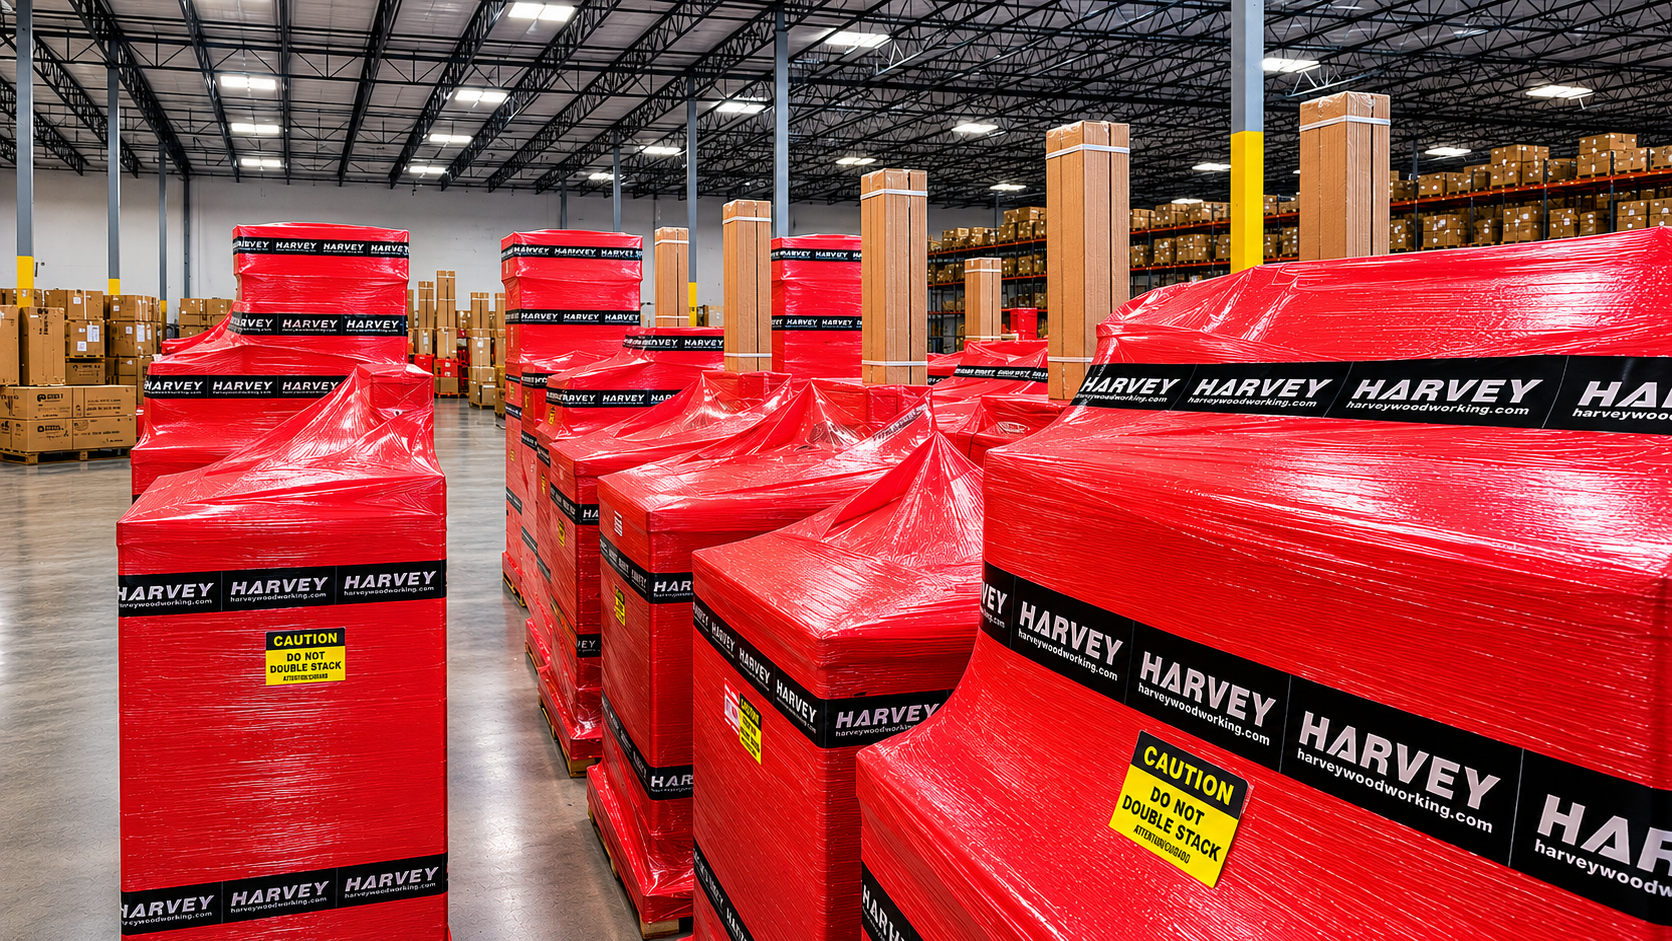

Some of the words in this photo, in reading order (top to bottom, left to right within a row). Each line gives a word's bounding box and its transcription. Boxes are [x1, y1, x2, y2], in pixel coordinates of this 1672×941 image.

[276, 241, 317, 250] HARVEY
[323, 242, 365, 251] HARVEY
[282, 319, 339, 329] HARVEY
[346, 320, 399, 329] HARVEY
[521, 312, 558, 320] HARVEY
[213, 381, 273, 391] HARVEY
[282, 381, 339, 391] HARVEY
[1079, 376, 1180, 394] HARVEY
[1193, 378, 1333, 398] HARVEY
[1352, 379, 1544, 403] HARVEY
[1577, 380, 1672, 408] HA
[602, 394, 645, 402] HARVEY
[651, 394, 676, 402] HAR
[1346, 400, 1529, 416] harveywoodworking.com
[230, 576, 328, 595] HARVEY
[344, 570, 437, 590] HARVEY
[653, 580, 693, 592] HAR
[273, 632, 338, 647] CAUTION
[287, 652, 302, 662] DO
[305, 651, 326, 661] NOT
[270, 663, 308, 673] DOUBLE
[311, 661, 342, 671] STACK
[739, 647, 771, 685] HARVEY
[776, 679, 817, 724] HARVEY
[1019, 601, 1123, 666] HARVEY
[1140, 651, 1276, 728] HARVEY
[1299, 710, 1500, 810] HARVEY
[835, 703, 940, 729] HARVEY
[1018, 628, 1118, 682] harveywoodworking.com
[1138, 682, 1270, 746] harveywoodworking.com
[1297, 748, 1493, 834] harveywoodworking.com
[1143, 745, 1235, 806] CAUTION
[1150, 786, 1171, 808] DO
[1173, 798, 1205, 826] NOT
[1122, 794, 1174, 834] DOUBLE
[1175, 824, 1222, 862] STACK
[231, 880, 329, 907] HARVEY
[345, 866, 439, 893] HARVEY
